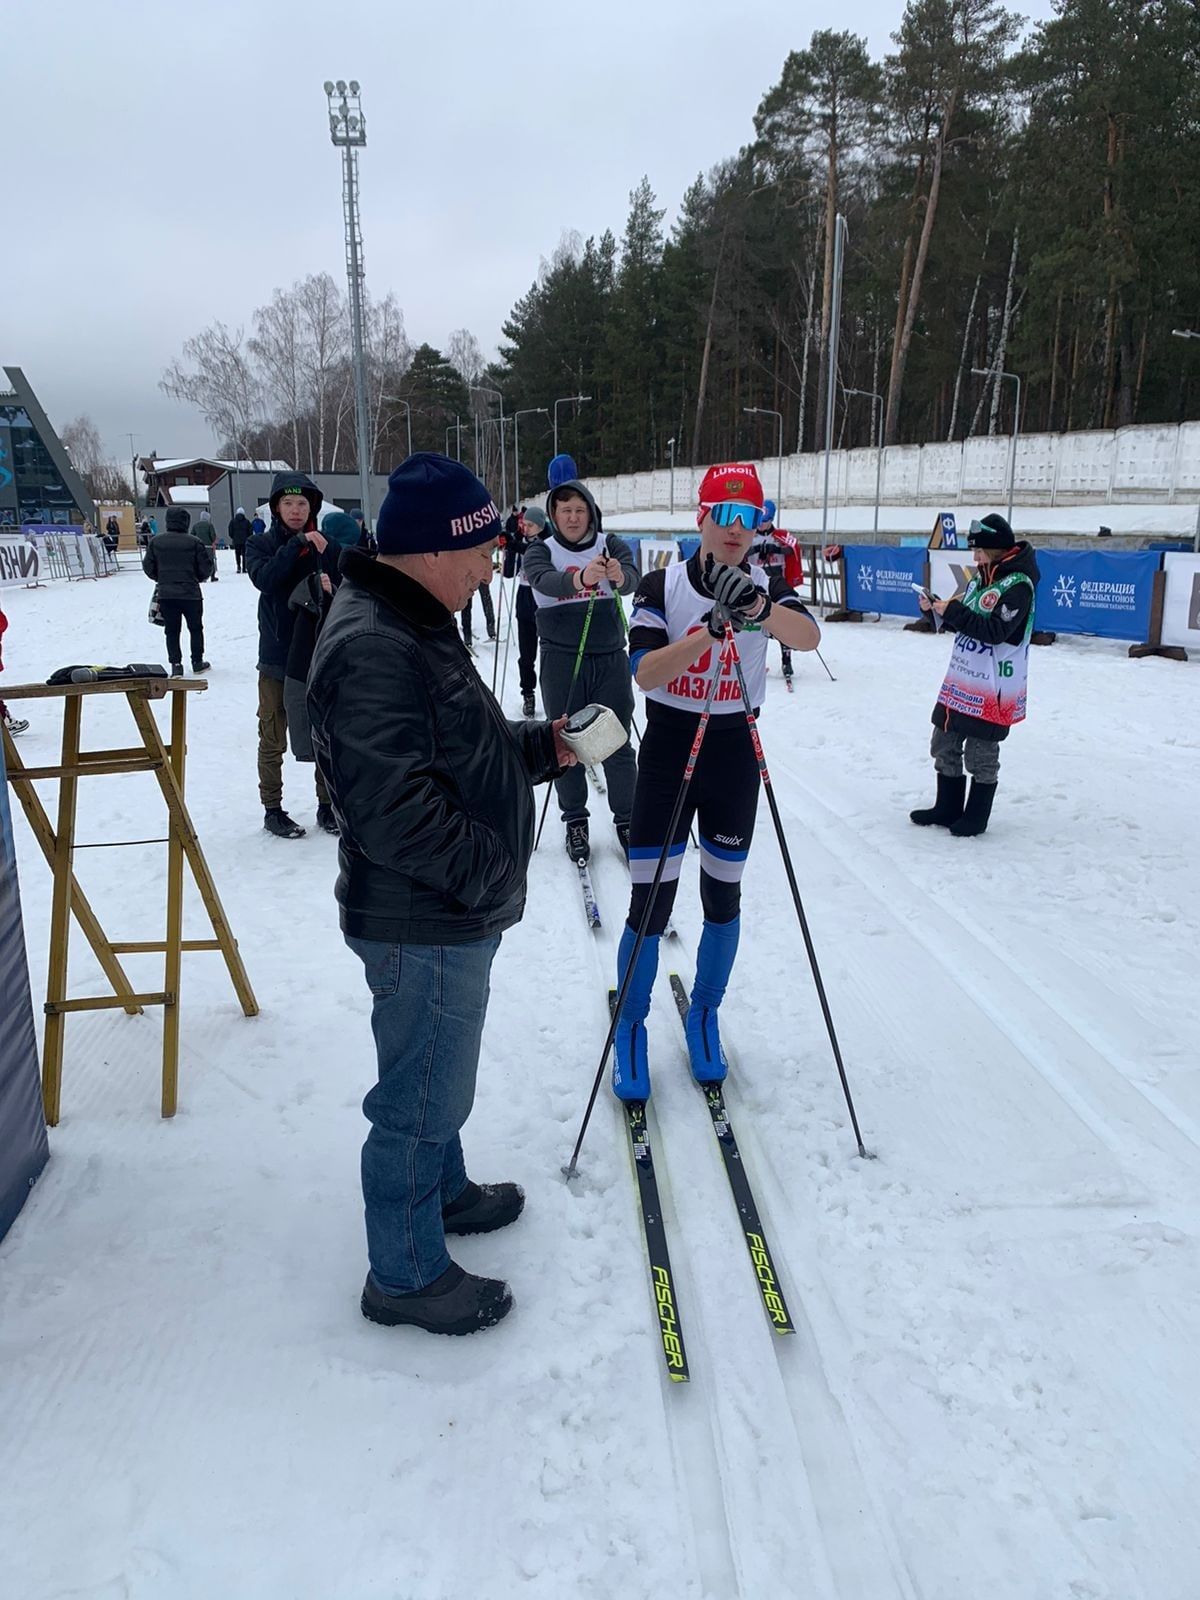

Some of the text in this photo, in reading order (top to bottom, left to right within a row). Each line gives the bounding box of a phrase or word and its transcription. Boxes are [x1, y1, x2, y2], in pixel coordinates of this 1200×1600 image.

[713, 467, 755, 479] LUKOIL
[1080, 580, 1136, 595] ФЕДЕРАЦИЯ
[1080, 592, 1135, 604] ЛЫЖНЫХ ГОНОК
[998, 660, 1014, 677] 16
[746, 1232, 788, 1324] FISCHER
[652, 1265, 684, 1369] FISCHER
